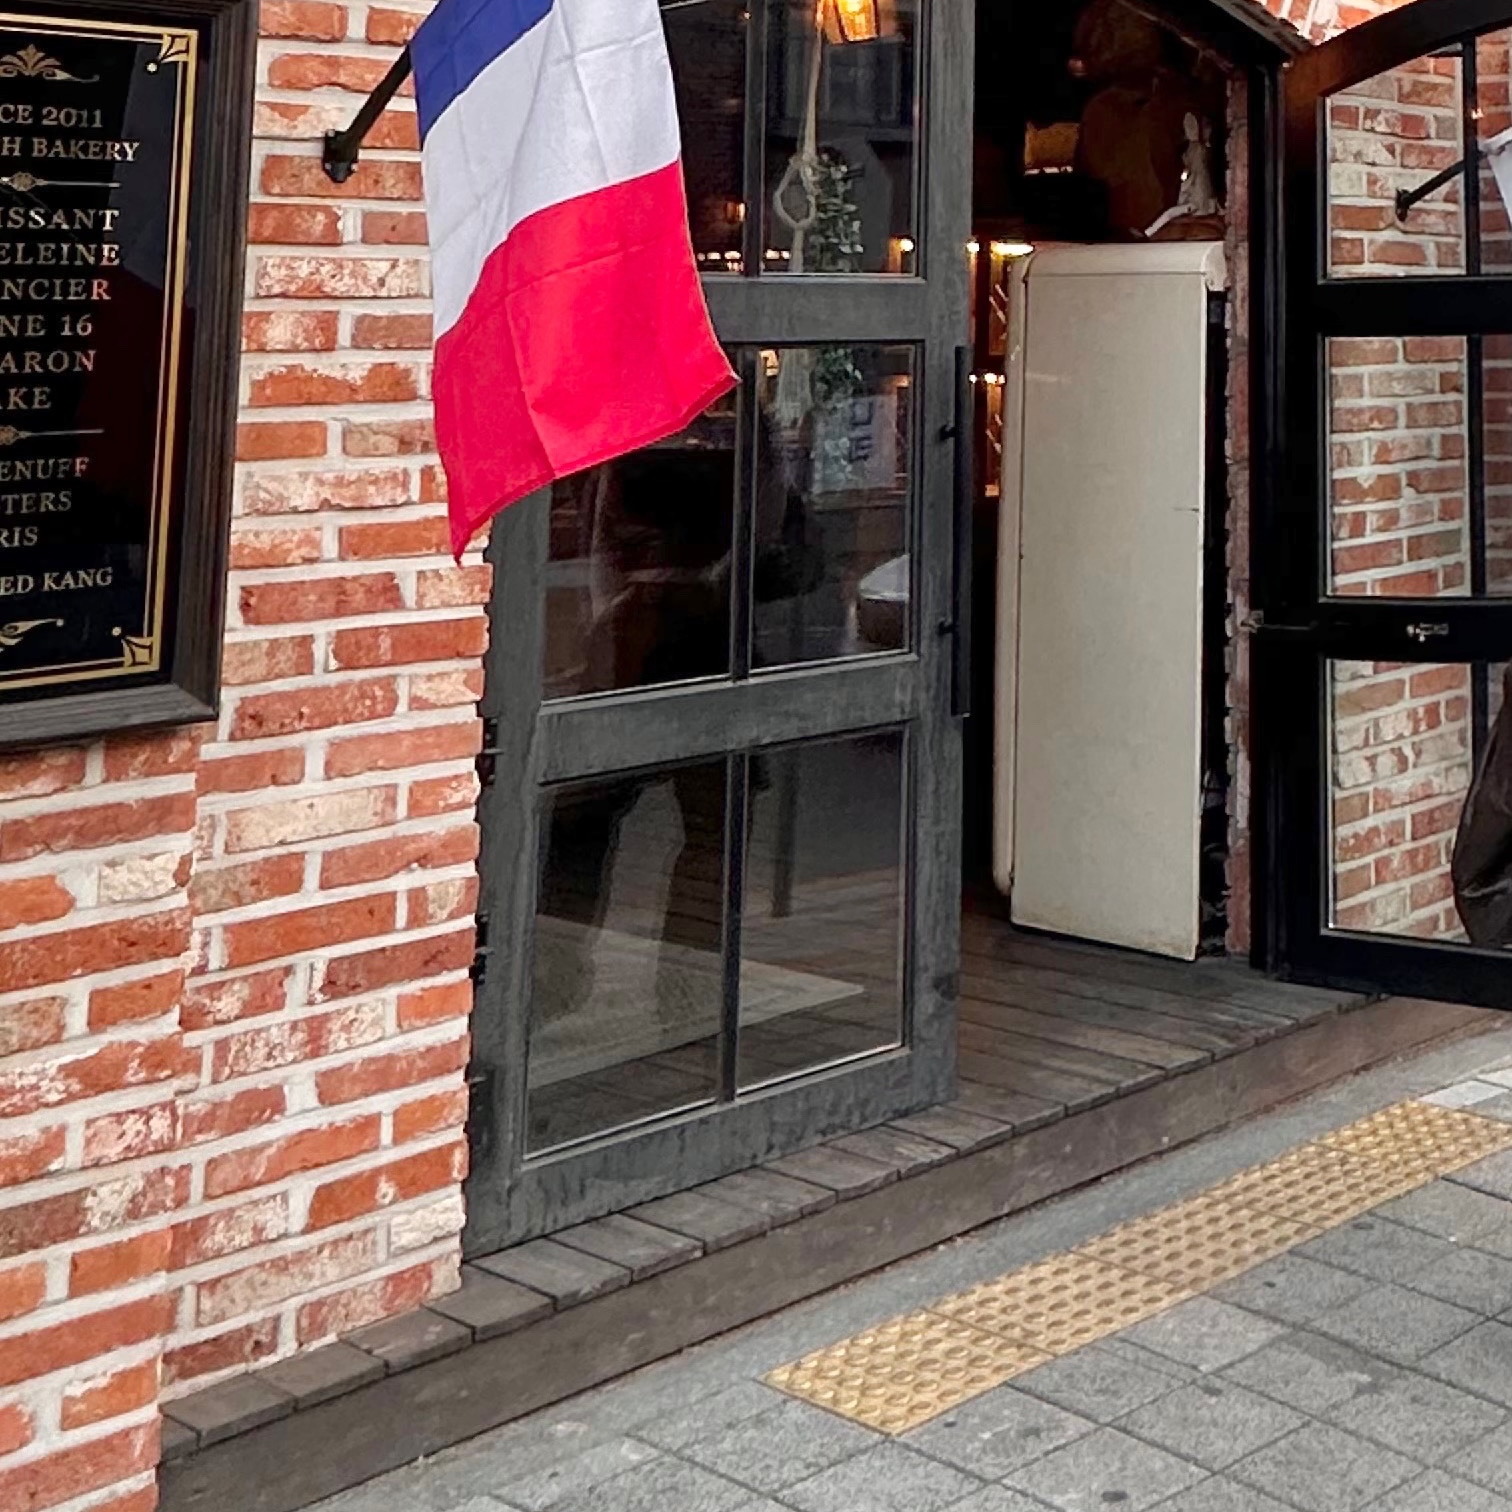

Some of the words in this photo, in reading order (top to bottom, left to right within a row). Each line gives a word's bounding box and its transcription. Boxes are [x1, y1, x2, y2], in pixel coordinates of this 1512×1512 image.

[42, 107, 103, 128] 2011
[32, 137, 140, 161] BAKERY
[1, 279, 112, 300] NCIER
[61, 314, 92, 336] 16
[0, 350, 96, 373] ARON
[0, 388, 51, 410] KE
[1, 491, 72, 514] TERS
[43, 567, 113, 592] KANG
